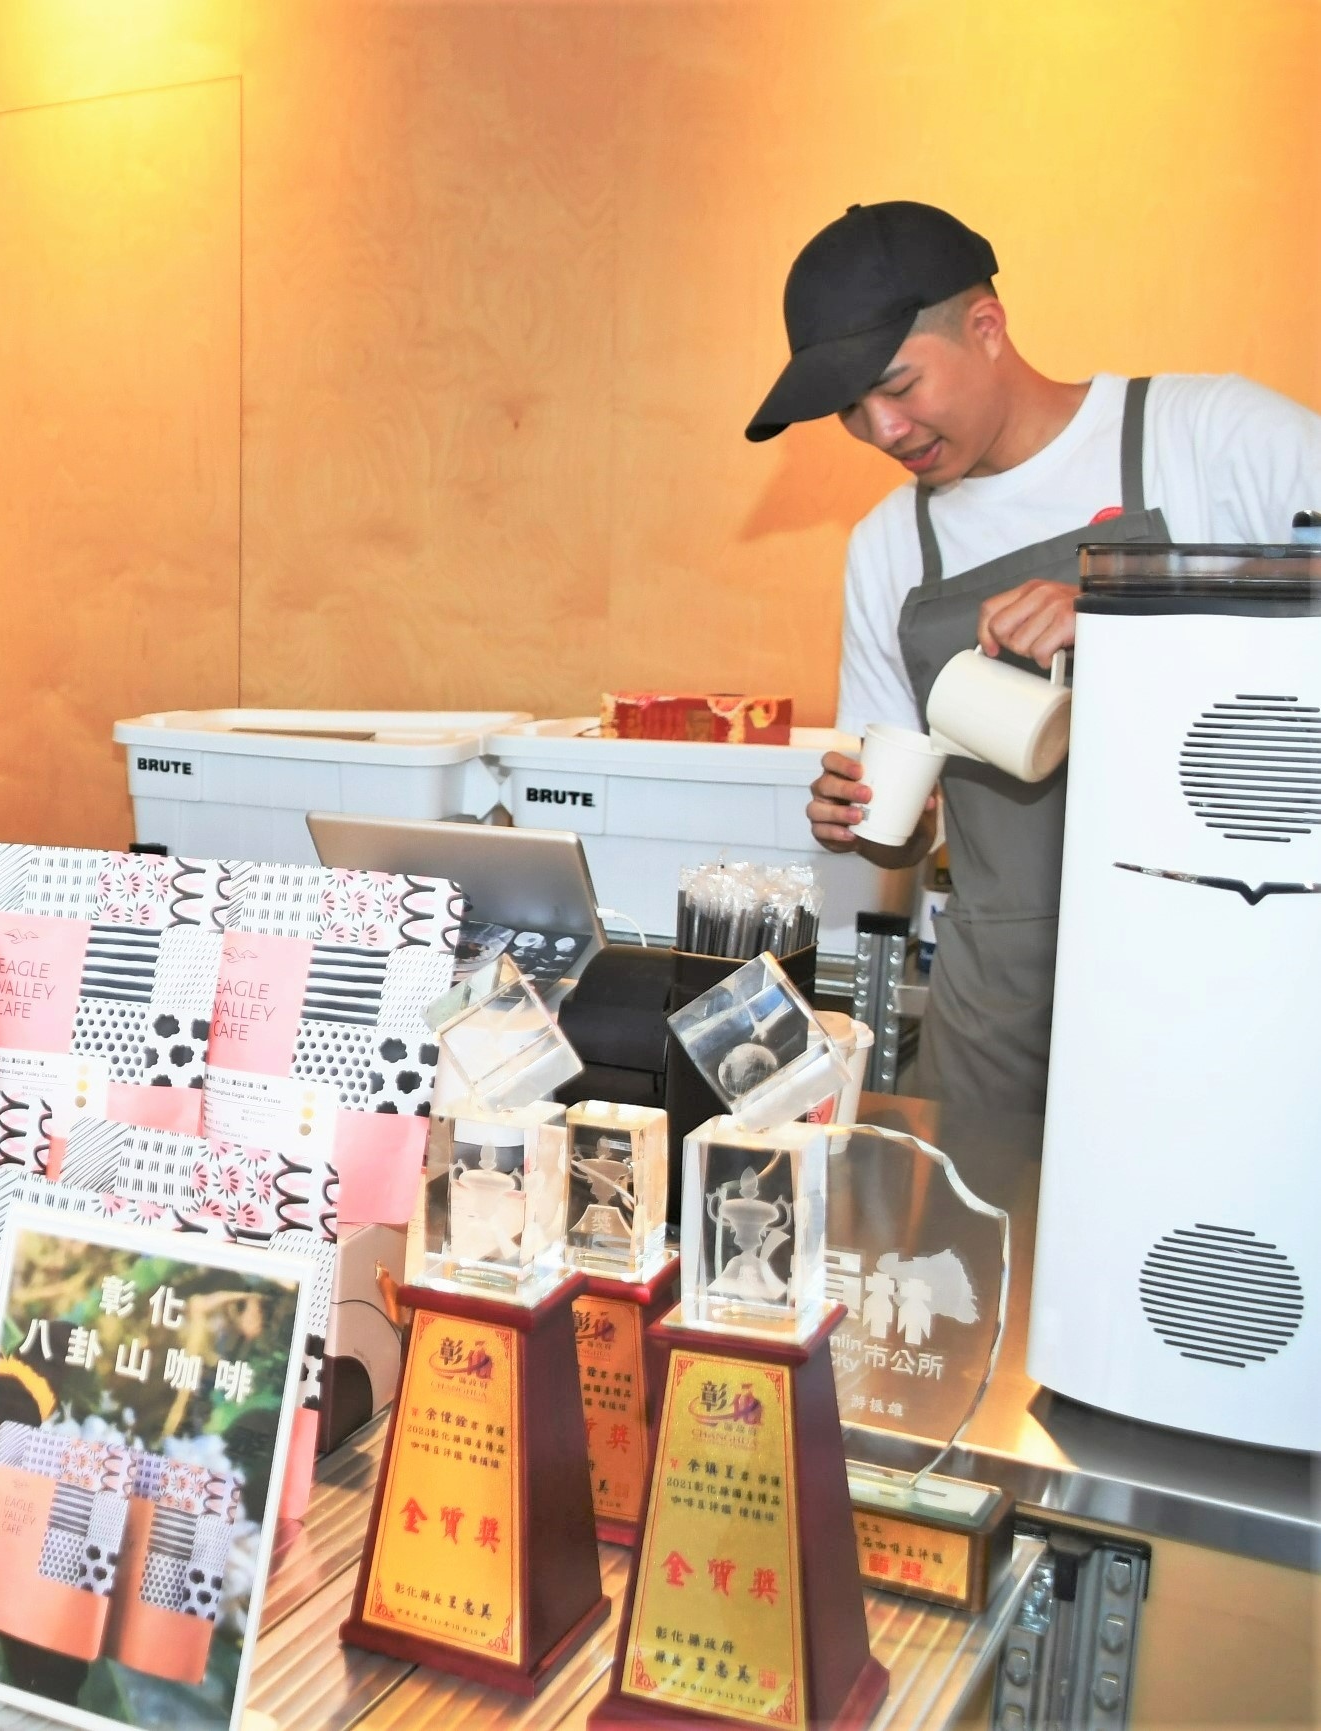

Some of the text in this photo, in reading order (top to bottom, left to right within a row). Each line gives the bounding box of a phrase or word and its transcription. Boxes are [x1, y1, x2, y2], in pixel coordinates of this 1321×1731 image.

[137, 757, 193, 775] BRUTE
[526, 787, 595, 807] BRUTE
[216, 977, 270, 1000] EAGLE
[213, 1000, 276, 1022] VALLEY
[213, 1019, 249, 1041] CAFE
[99, 1275, 186, 1329] 彰化
[829, 1334, 862, 1352] nlin
[18, 1318, 255, 1404] 八卦山咖啡
[863, 1343, 944, 1381] 市公所
[4, 1495, 34, 1513] EAGLE
[0, 1522, 22, 1537] CAFE
[399, 1496, 502, 1555] 金質獎
[661, 1550, 780, 1606] 金質獎
[654, 1625, 735, 1655] 彰化縣政府
